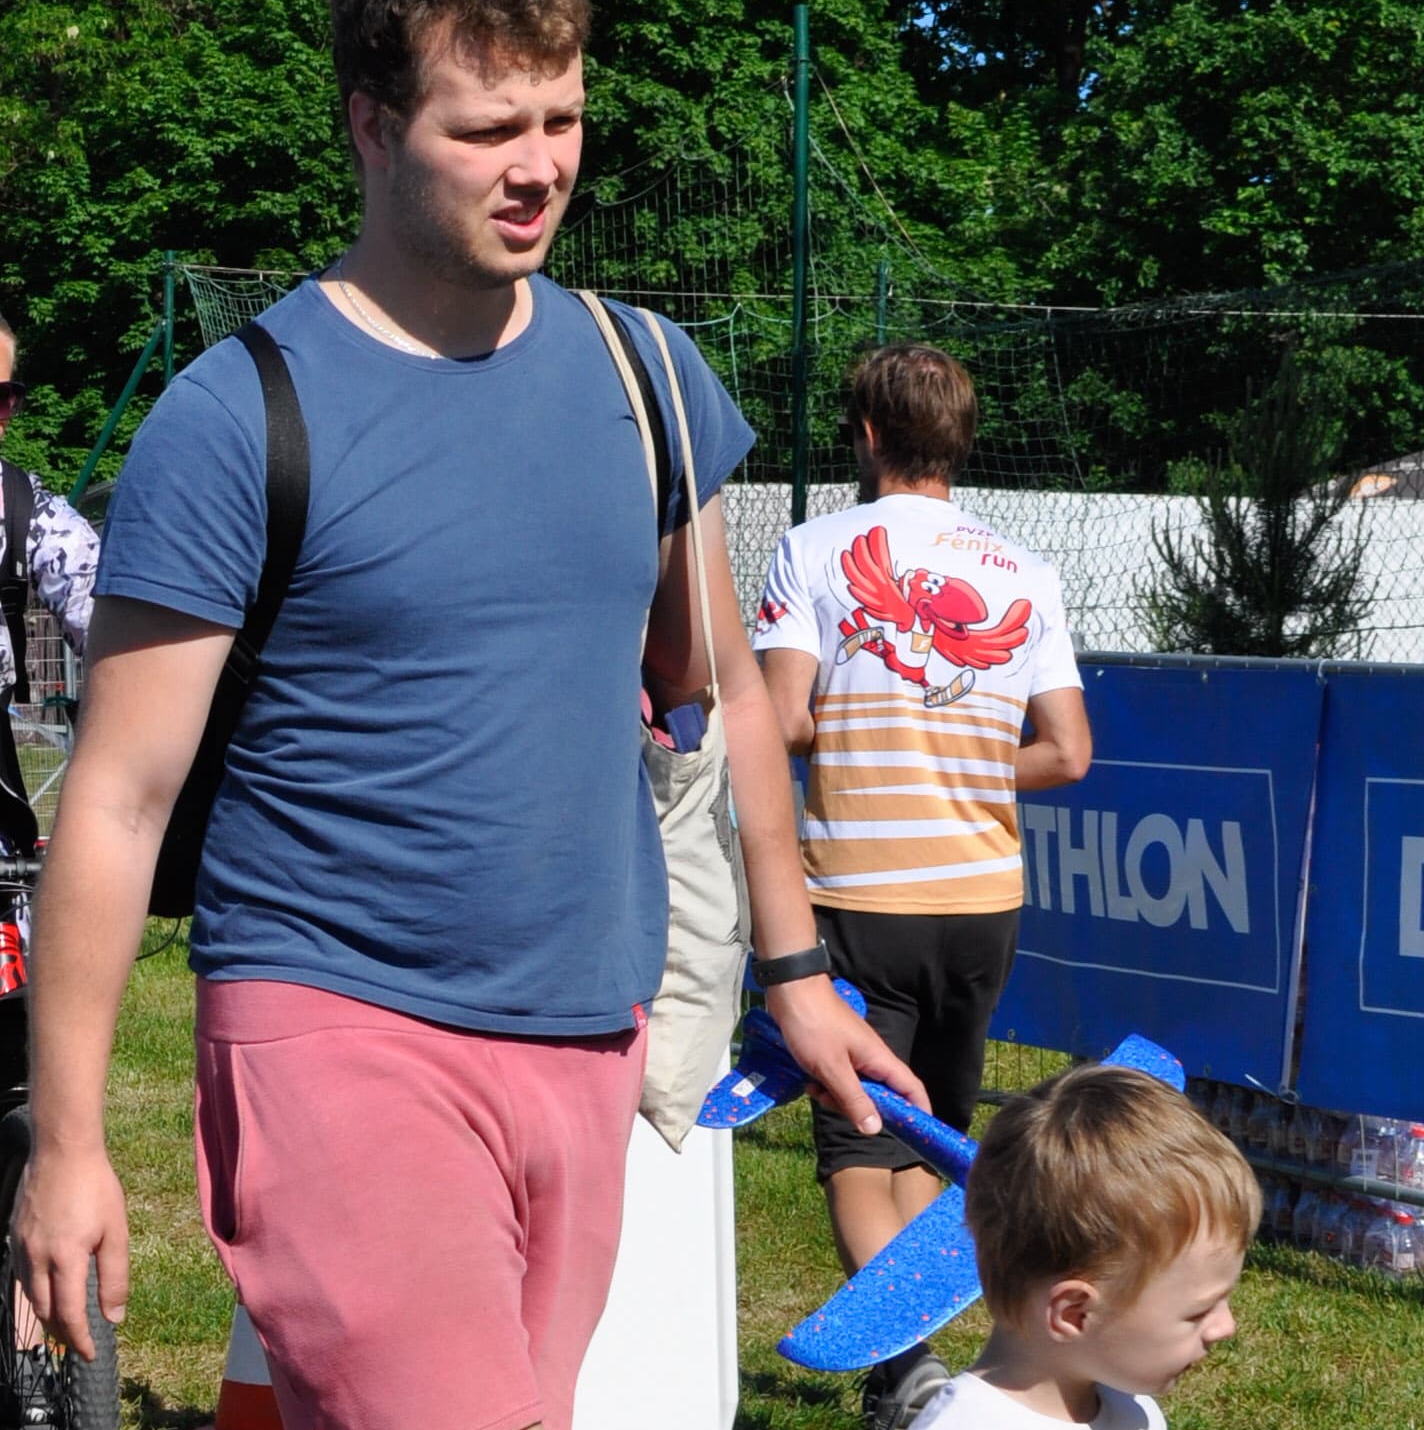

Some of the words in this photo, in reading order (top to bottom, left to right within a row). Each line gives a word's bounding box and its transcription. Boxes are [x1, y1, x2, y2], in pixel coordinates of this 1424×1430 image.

[928, 532, 1003, 552] Fénix
[980, 553, 1018, 573] run
[1016, 802, 1251, 935] THLON
